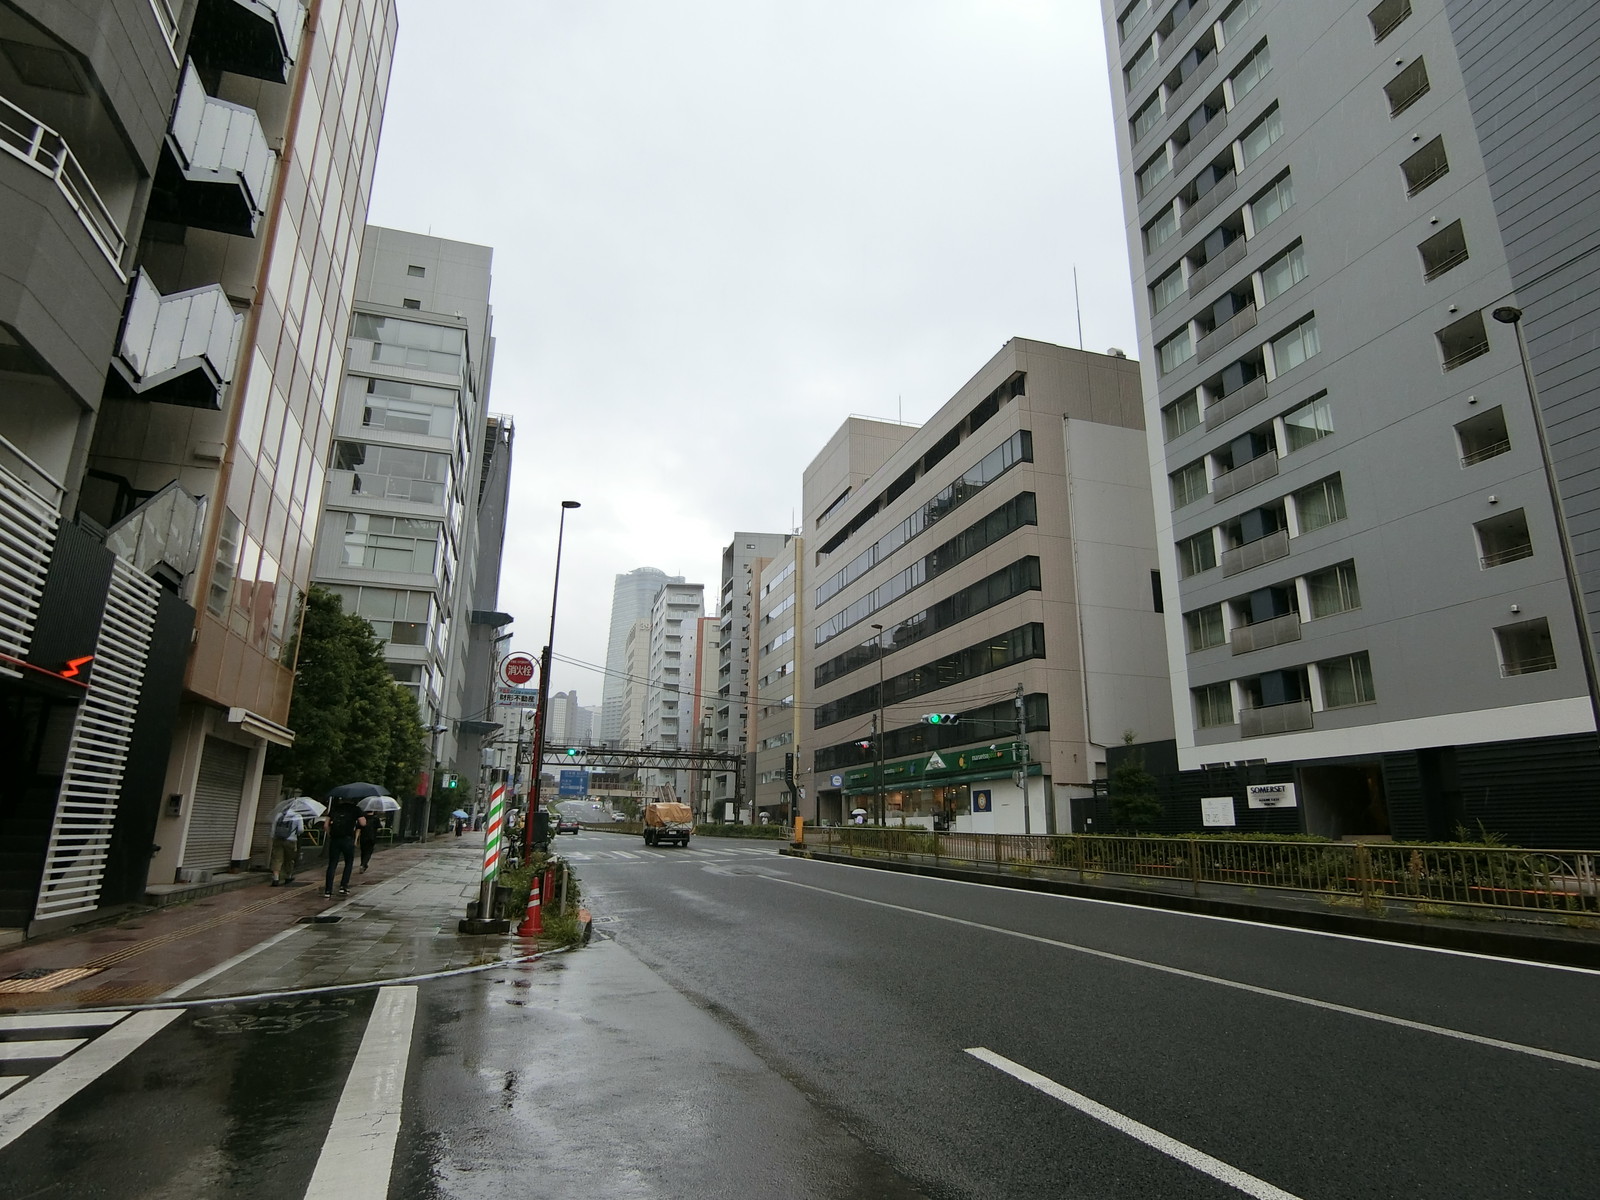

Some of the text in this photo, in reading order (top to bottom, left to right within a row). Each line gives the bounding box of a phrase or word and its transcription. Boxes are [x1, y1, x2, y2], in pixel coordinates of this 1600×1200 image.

[508, 665, 532, 676] 消火栓
[500, 694, 535, 702] 財形不動産
